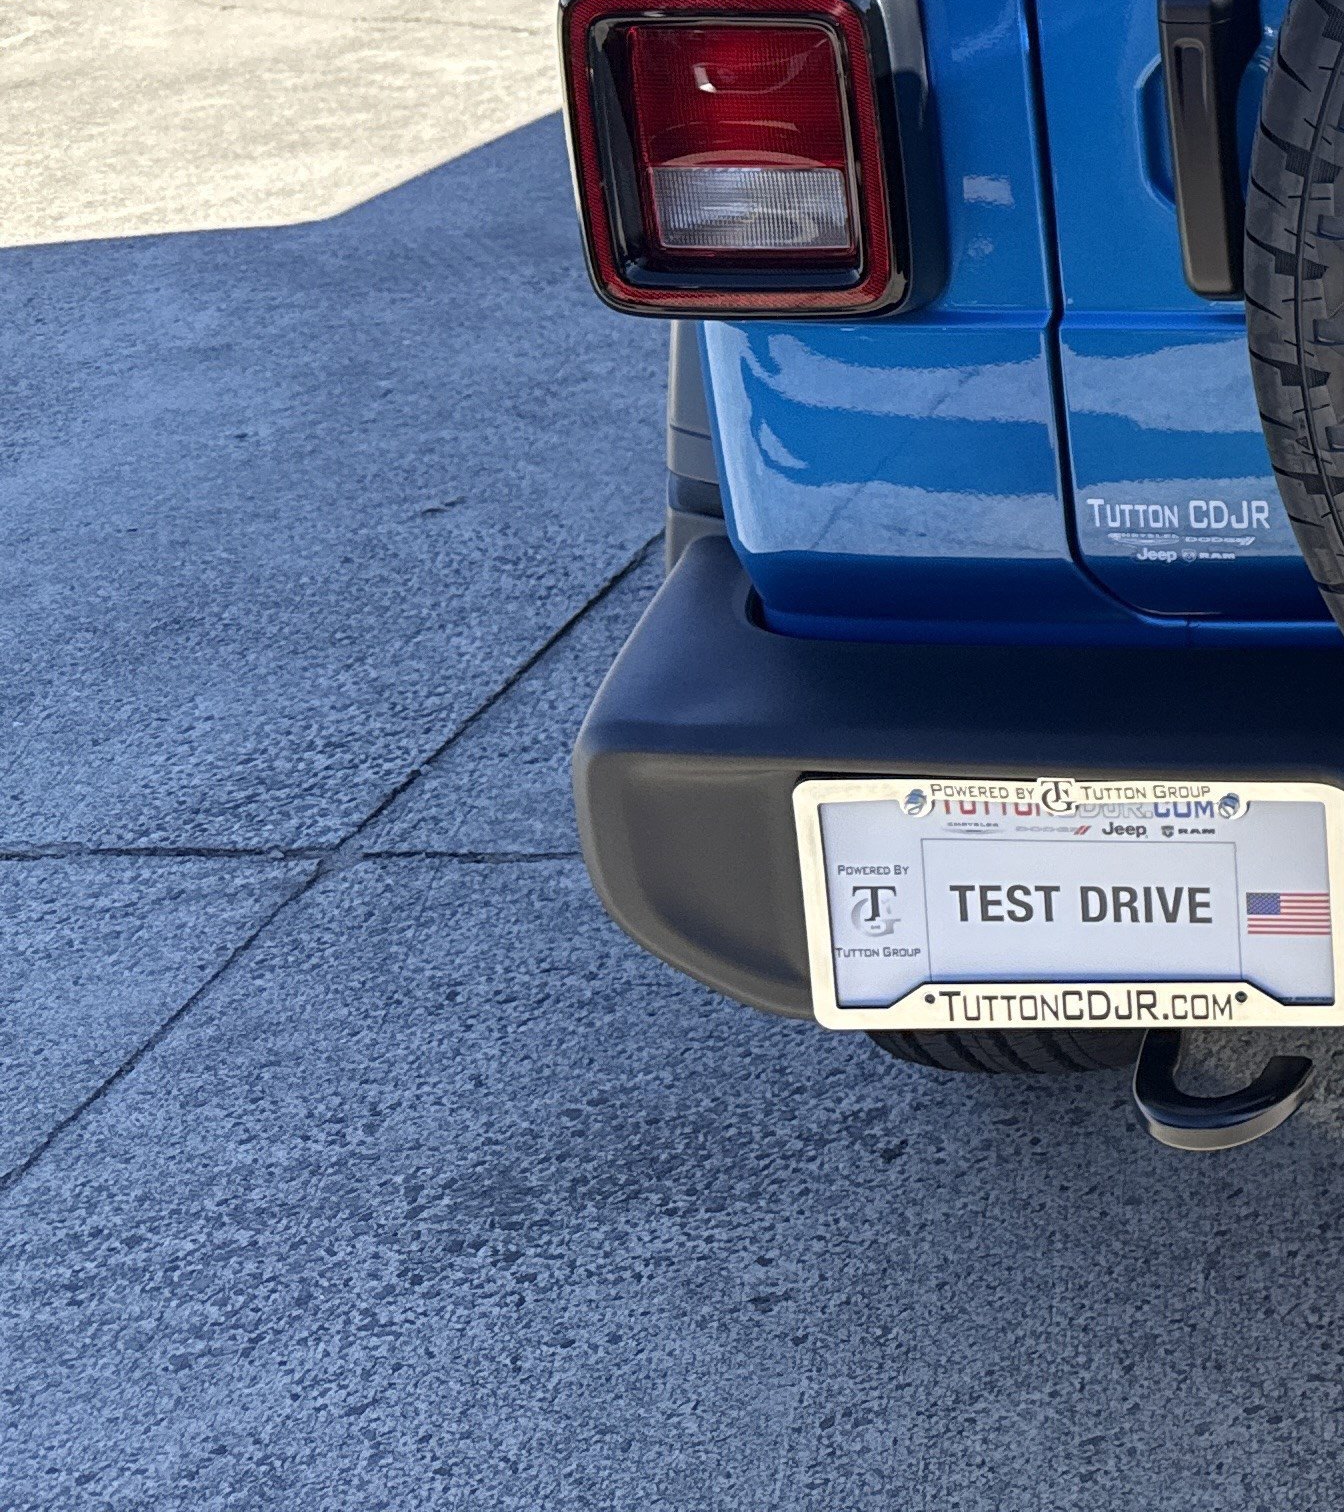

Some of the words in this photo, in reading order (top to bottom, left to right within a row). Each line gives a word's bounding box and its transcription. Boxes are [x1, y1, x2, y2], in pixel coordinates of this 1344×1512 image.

[1086, 498, 1180, 529] TUTTON
[1188, 500, 1271, 530] CDJR
[1136, 547, 1178, 563] Jeep
[1199, 552, 1236, 560] RAM
[929, 783, 1009, 799] POWERED
[1015, 787, 1035, 800] BY
[1080, 785, 1146, 801] TUTTON
[1152, 784, 1212, 799] GROUP
[1101, 821, 1147, 837] Jeep
[837, 864, 891, 876] POWERED
[894, 864, 910, 876] BY
[949, 884, 1061, 923] TEST
[1080, 885, 1213, 925] DRIVE
[835, 947, 880, 958] TUTTON
[882, 946, 921, 958] GROUP
